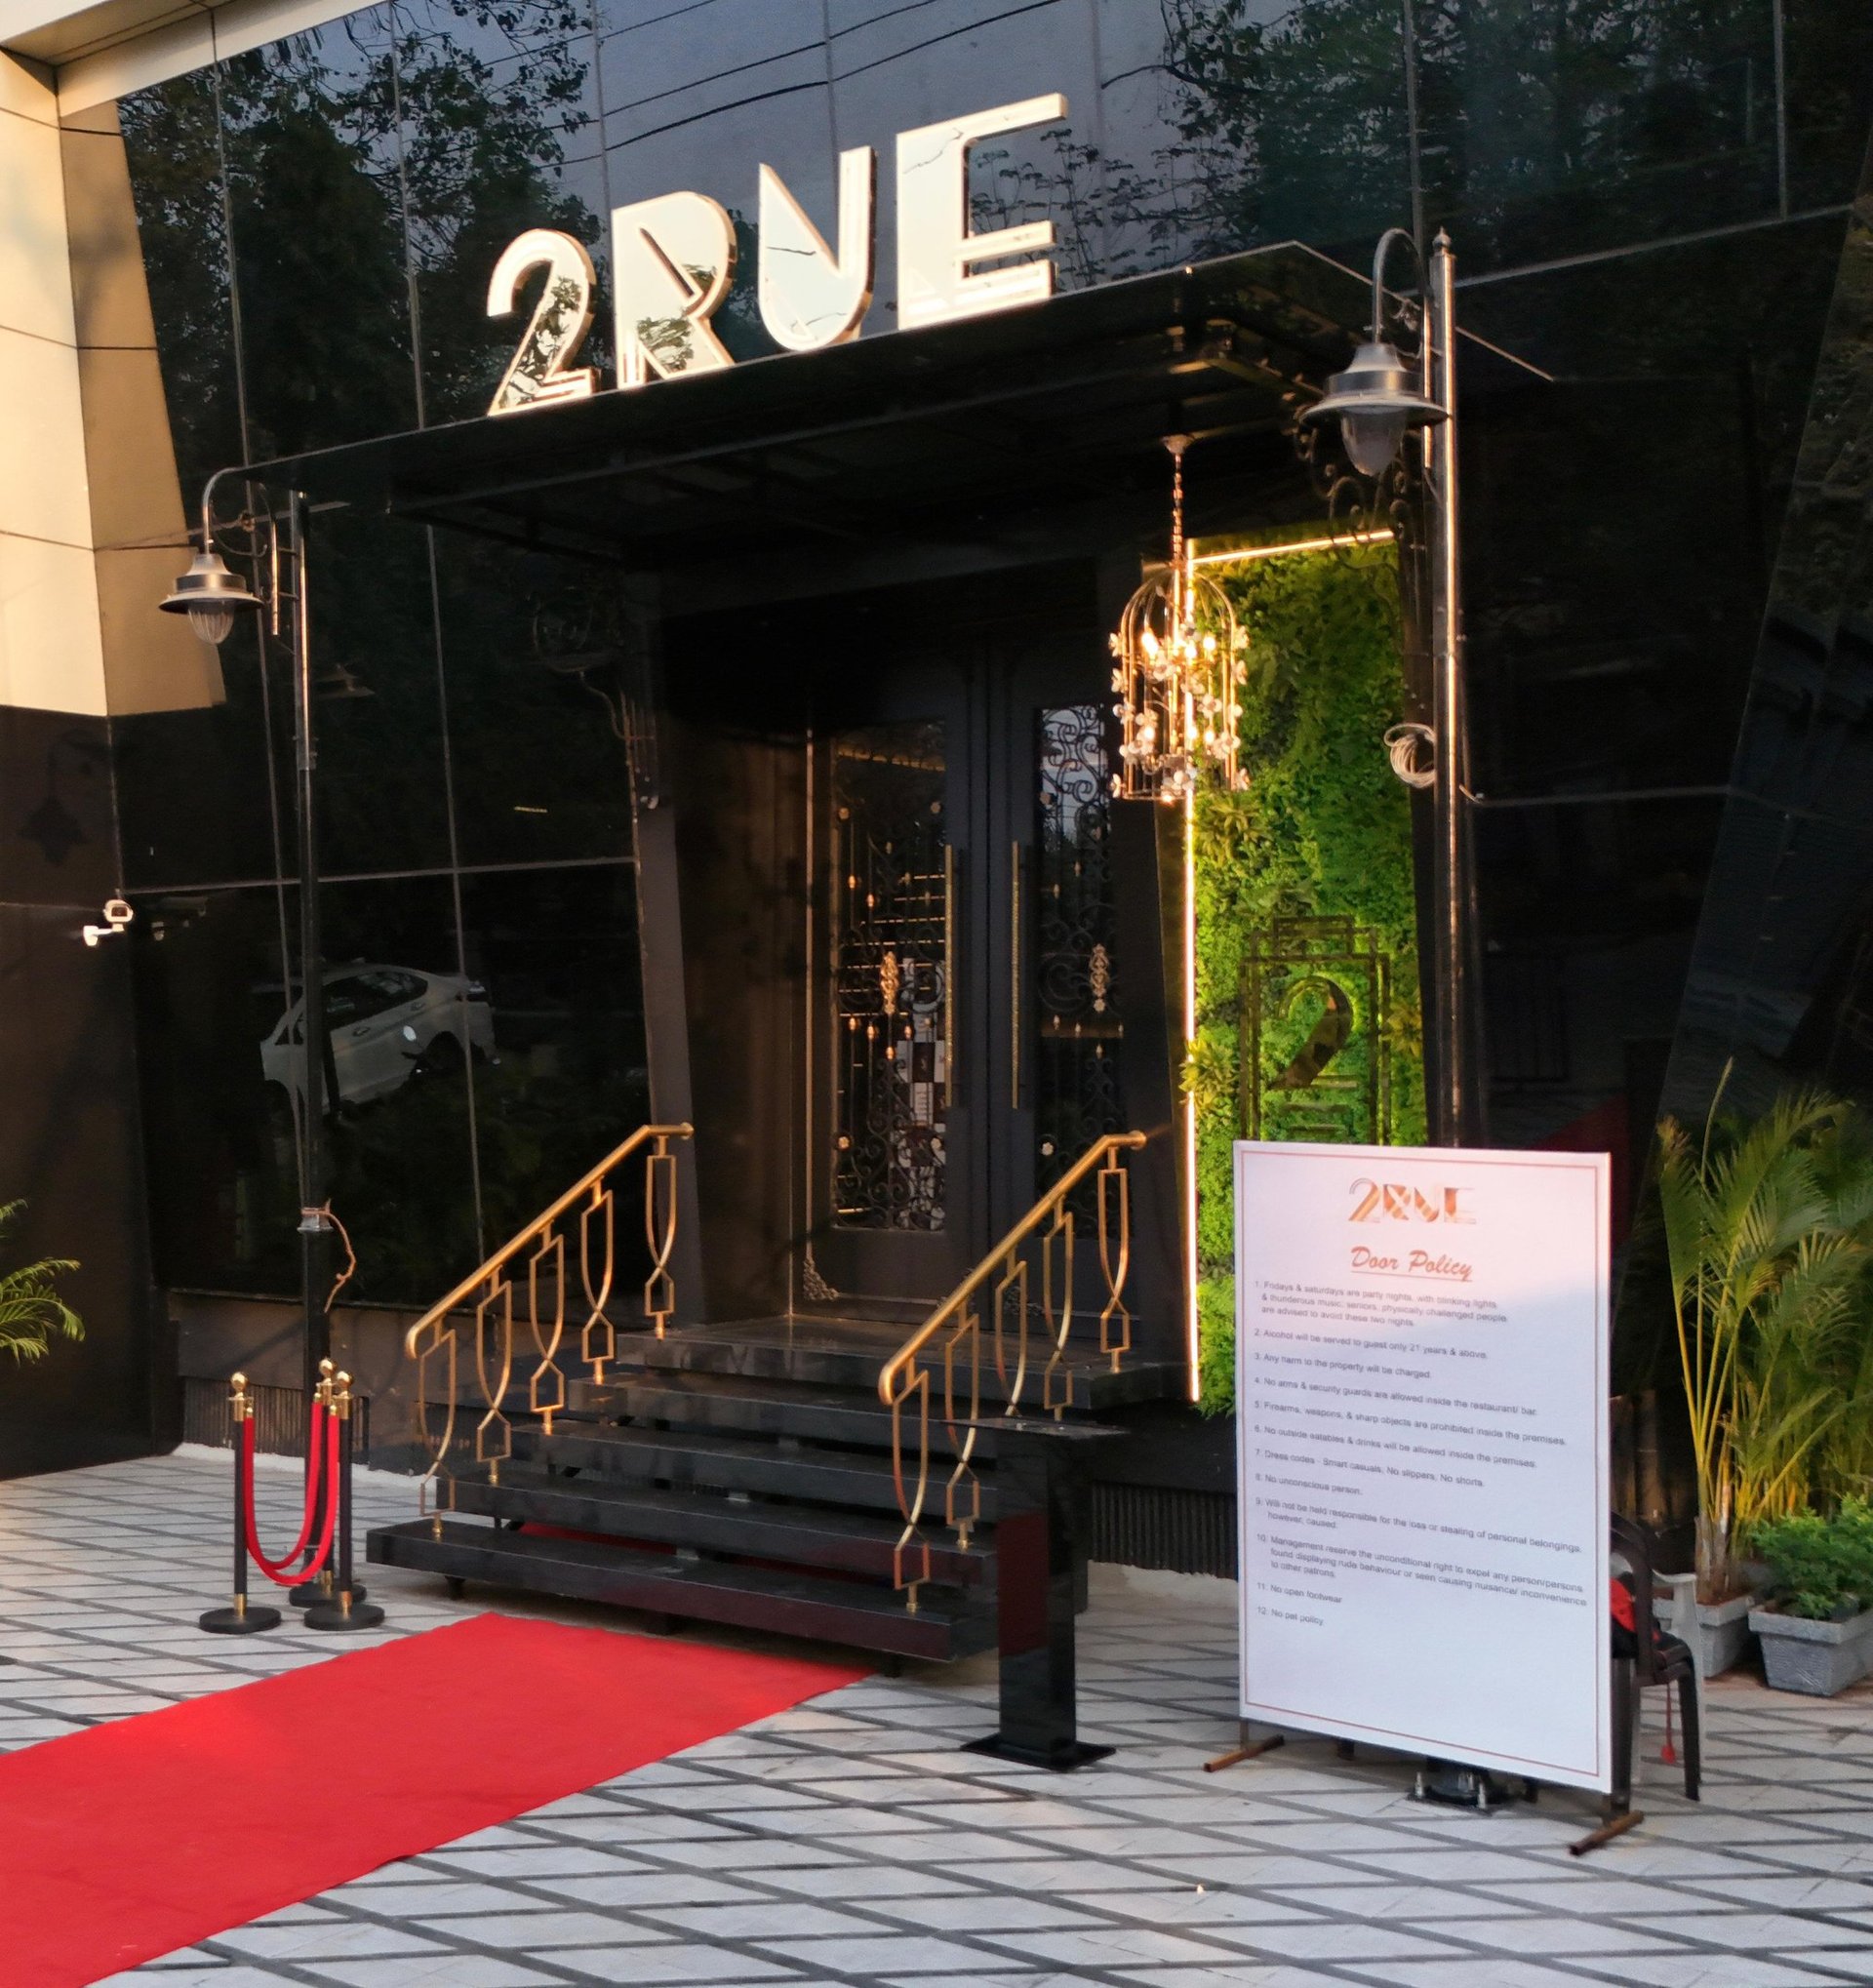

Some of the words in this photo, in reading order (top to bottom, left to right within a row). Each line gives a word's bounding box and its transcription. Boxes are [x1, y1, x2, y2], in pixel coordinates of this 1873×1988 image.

[1351, 1246, 1399, 1270] Door
[1409, 1250, 1473, 1283] Policy
[1263, 1280, 1294, 1292] Fridays
[1295, 1283, 1301, 1292] &
[1303, 1286, 1343, 1295] saturdays
[1362, 1291, 1382, 1299] party
[1437, 1296, 1470, 1307] blinking
[1269, 1293, 1315, 1304] thunderous
[1381, 1304, 1422, 1316] physically
[1426, 1308, 1473, 1320] challenged
[1276, 1307, 1307, 1316] advised
[1344, 1313, 1368, 1322] these
[1262, 1329, 1293, 1339] Alcohol
[1322, 1336, 1351, 1345] served
[1363, 1340, 1387, 1349] guest
[1388, 1342, 1407, 1352] only
[1409, 1342, 1419, 1352] 21
[1422, 1346, 1449, 1355] years
[1449, 1347, 1456, 1356] &
[1263, 1353, 1279, 1364] Any
[1329, 1361, 1364, 1372] property
[1366, 1364, 1378, 1372] will
[1381, 1366, 1392, 1374] be
[1263, 1377, 1276, 1386] No
[1308, 1383, 1340, 1395] security
[1342, 1387, 1372, 1397] guards
[1390, 1391, 1423, 1403] allowed
[1426, 1396, 1451, 1406] inside
[1454, 1399, 1467, 1408] the
[1345, 1411, 1352, 1419] &
[1355, 1413, 1378, 1423] sharp
[1380, 1416, 1411, 1427] objects
[1430, 1422, 1473, 1434] prohibited
[1476, 1428, 1503, 1438] inside
[1504, 1430, 1520, 1440] the
[1263, 1425, 1276, 1434] No
[1278, 1429, 1307, 1439] outside
[1309, 1432, 1344, 1444] eatables
[1347, 1436, 1353, 1445] &
[1355, 1438, 1380, 1448] drinks
[1399, 1443, 1410, 1451] be
[1413, 1445, 1445, 1456] allowed
[1449, 1451, 1474, 1459] inside
[1476, 1452, 1491, 1462] the
[1264, 1449, 1289, 1460] Dress
[1289, 1454, 1315, 1464] codes
[1322, 1457, 1348, 1468] Smart
[1385, 1466, 1400, 1475] No
[1439, 1473, 1453, 1482] No
[1264, 1474, 1276, 1483] No
[1278, 1478, 1329, 1491] unconscious
[1264, 1498, 1280, 1507] Will
[1281, 1501, 1295, 1510] not
[1296, 1503, 1307, 1512] be
[1309, 1505, 1327, 1515] held
[1329, 1509, 1376, 1522] responsible
[1379, 1515, 1390, 1524] for
[1392, 1517, 1407, 1527] the
[1409, 1520, 1426, 1531] loss
[1440, 1525, 1474, 1538] stealing
[1487, 1532, 1527, 1544] personal
[1270, 1535, 1323, 1551] Management
[1325, 1545, 1357, 1557] reserve
[1358, 1549, 1372, 1559] the
[1374, 1554, 1431, 1569] unconditional
[1432, 1562, 1453, 1572] right
[1455, 1565, 1463, 1573] to
[1465, 1568, 1490, 1577] expel
[1492, 1571, 1508, 1582] any
[1270, 1560, 1278, 1569] to
[1280, 1562, 1300, 1571] other
[1270, 1547, 1293, 1559] found
[1295, 1552, 1336, 1568] displaying
[1337, 1560, 1357, 1569] rude
[1359, 1562, 1401, 1575] behaviour
[1415, 1571, 1436, 1581] seen
[1438, 1575, 1472, 1589] causing
[1520, 1589, 1586, 1606] inconvenience
[1269, 1584, 1283, 1593] No
[1283, 1587, 1304, 1596] open
[1305, 1590, 1342, 1603] footwear
[1271, 1608, 1283, 1617] No
[1285, 1611, 1297, 1620] pet
[1299, 1614, 1323, 1626] policy
